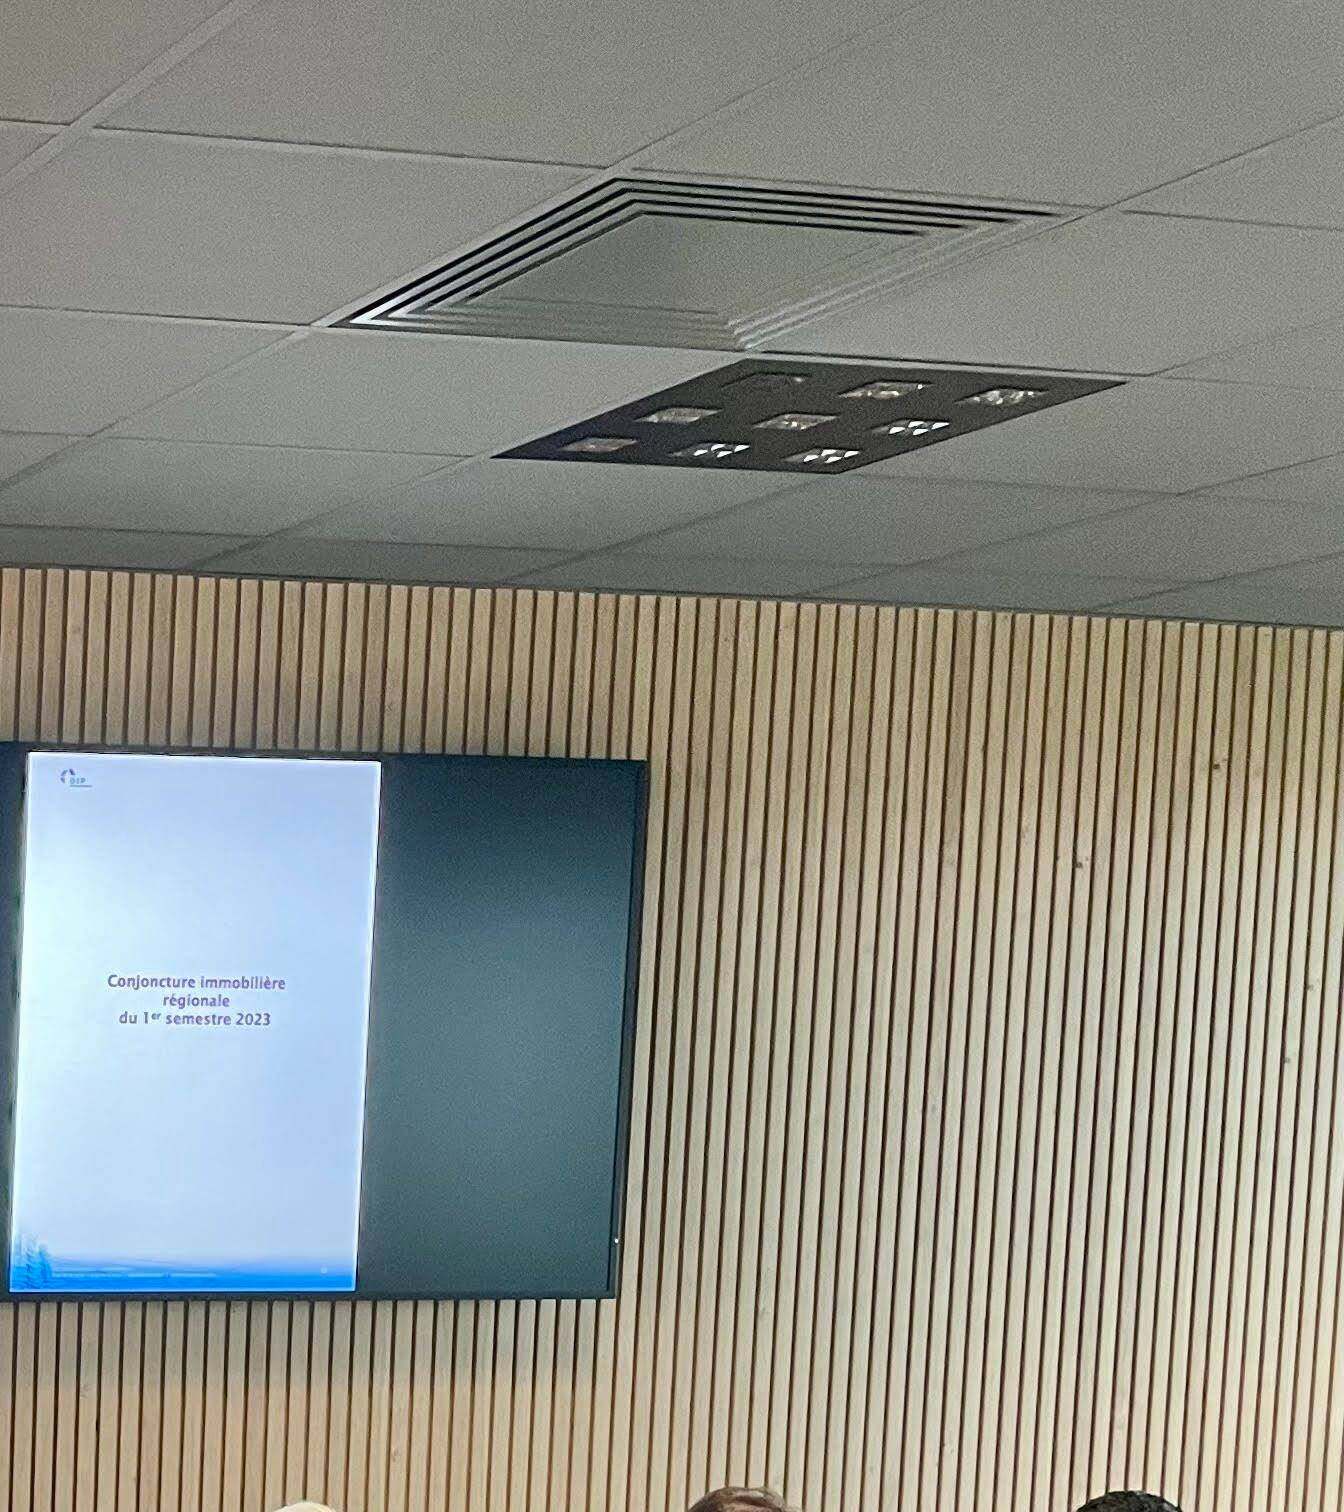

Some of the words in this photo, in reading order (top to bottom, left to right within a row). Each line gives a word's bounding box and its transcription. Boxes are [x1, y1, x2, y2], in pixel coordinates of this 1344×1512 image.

[107, 974, 196, 990] Conjoncture
[201, 975, 287, 991] immobilière
[162, 994, 231, 1010] régionale
[119, 1011, 138, 1025] du
[166, 1013, 232, 1026] semestre
[236, 1013, 272, 1027] 2023
